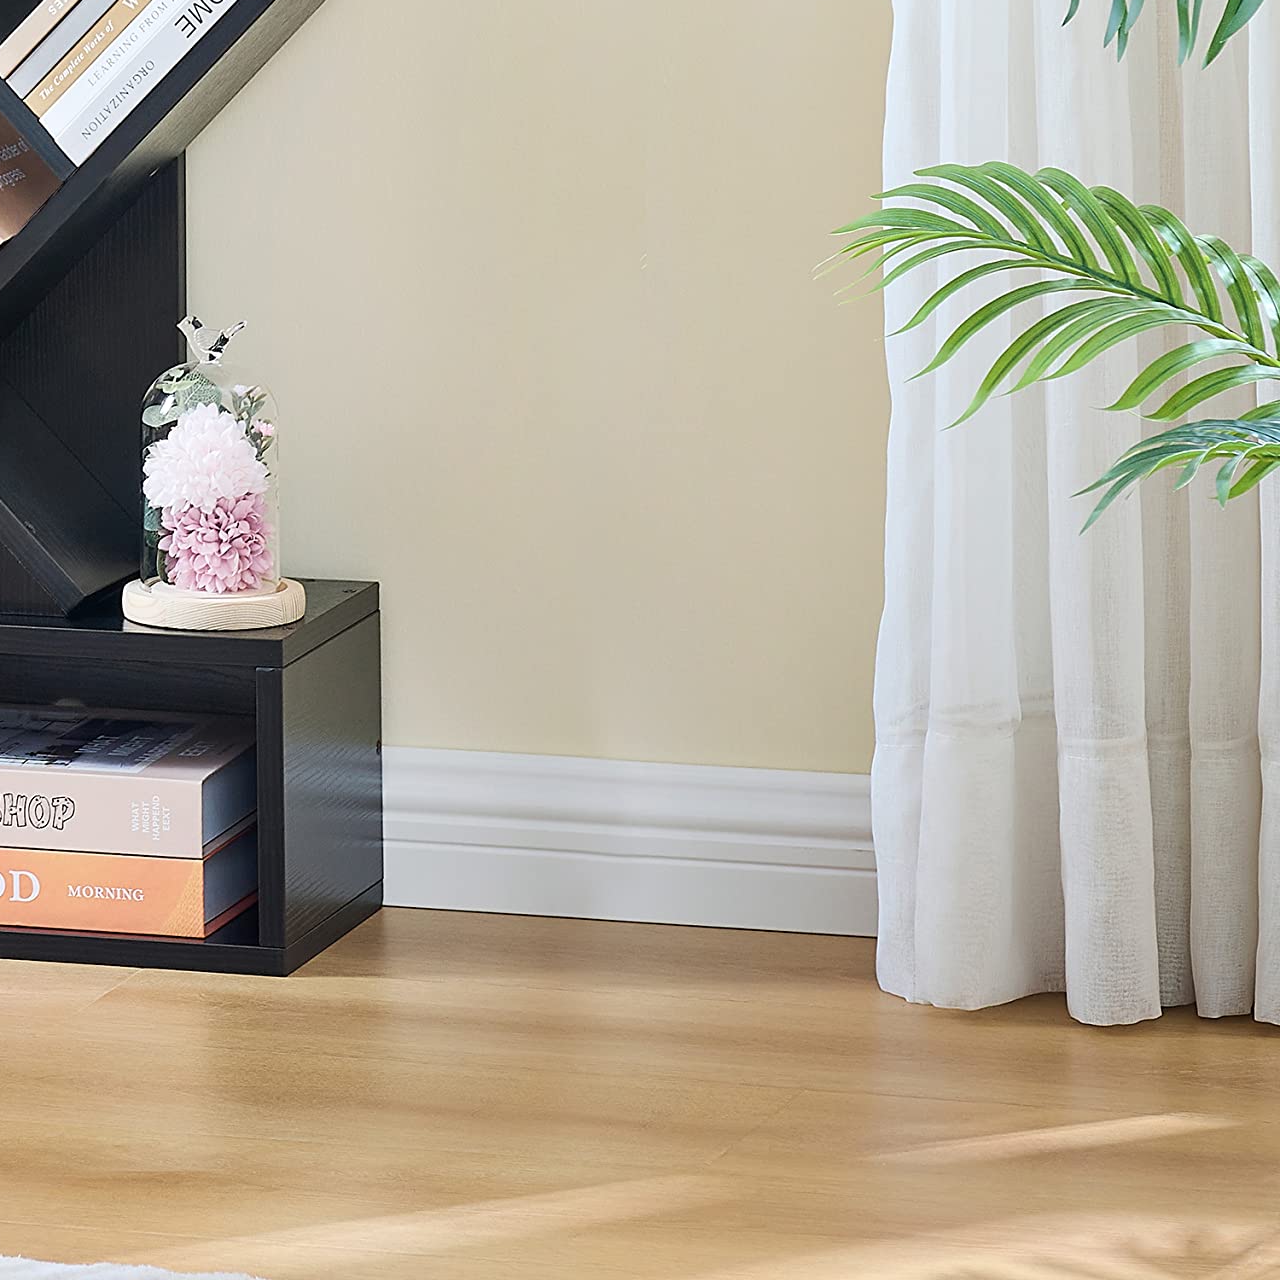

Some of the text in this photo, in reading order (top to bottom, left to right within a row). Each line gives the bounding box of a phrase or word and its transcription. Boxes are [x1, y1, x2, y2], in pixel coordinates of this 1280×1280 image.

[38, 19, 115, 100] The Complete Works of
[87, 32, 139, 87] LEARNING
[138, 1, 168, 33] FROM
[81, 59, 156, 141] ORGANIZATION
[131, 802, 139, 832] WHAT
[142, 800, 150, 832] MIGHT
[152, 795, 160, 841] HAPPEND
[162, 807, 170, 831] EEXT
[67, 885, 145, 902] MORNING
